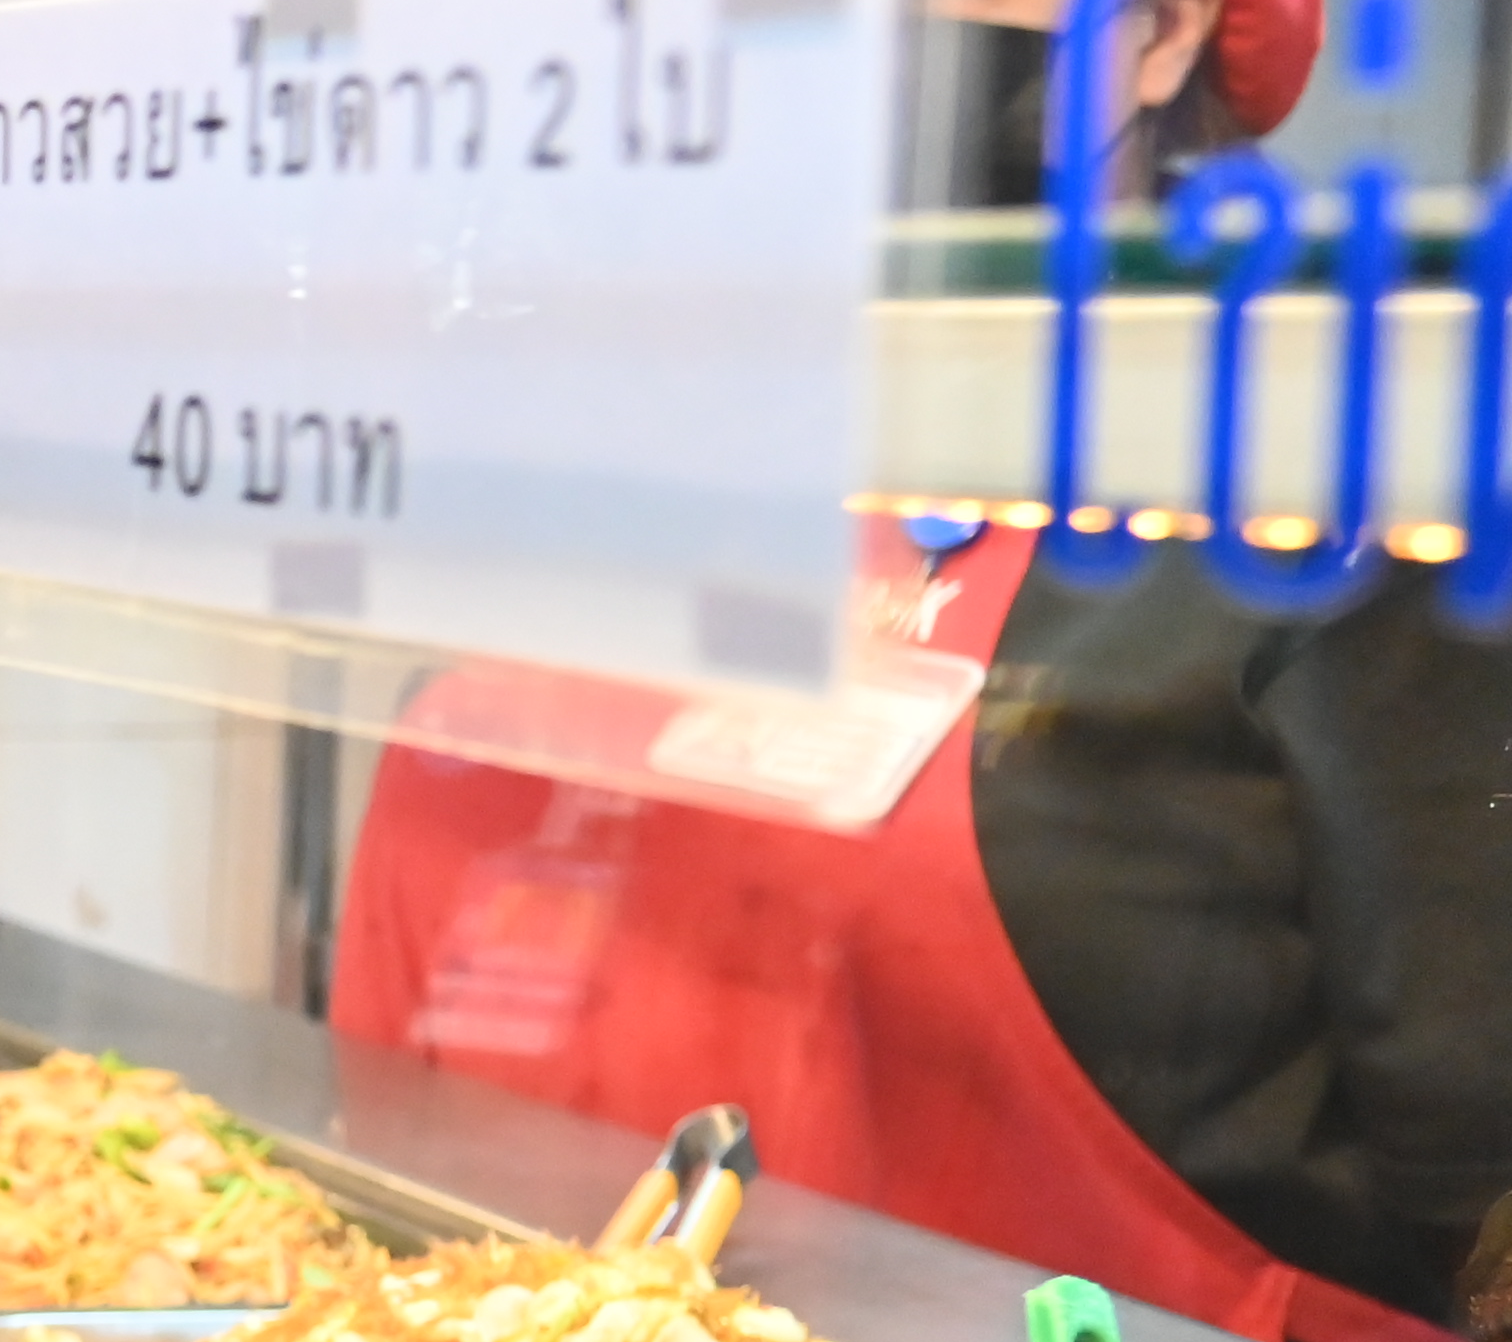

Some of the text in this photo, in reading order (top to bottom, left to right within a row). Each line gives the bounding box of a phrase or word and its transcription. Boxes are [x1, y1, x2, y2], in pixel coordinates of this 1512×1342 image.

[529, 55, 577, 168] 2
[130, 392, 403, 519] 40 บาท
